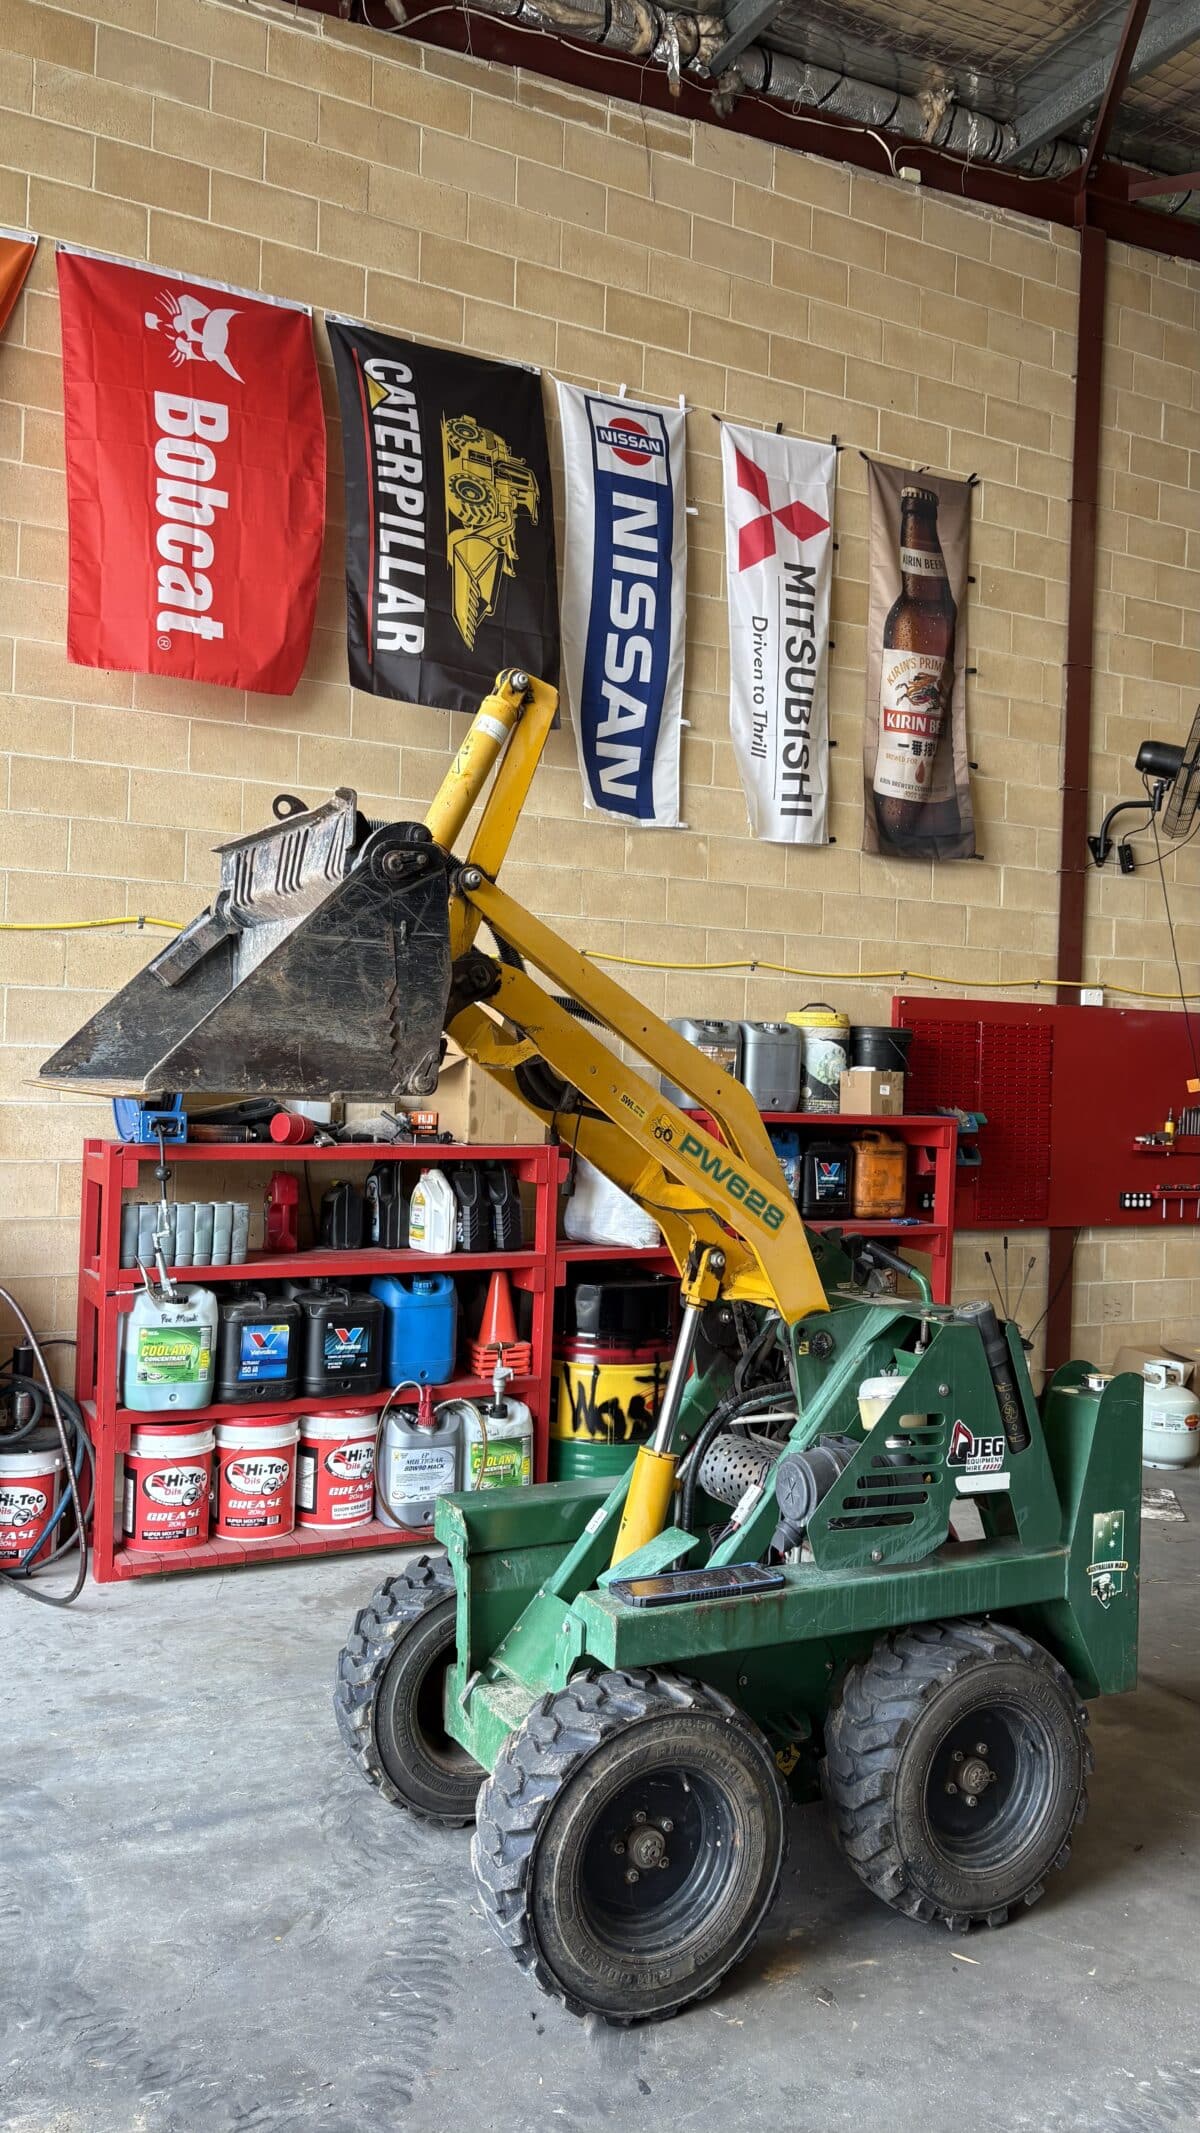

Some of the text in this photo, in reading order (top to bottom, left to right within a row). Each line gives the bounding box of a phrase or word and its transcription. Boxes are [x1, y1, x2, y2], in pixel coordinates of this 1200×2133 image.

[598, 429, 662, 454] NISSAN
[363, 358, 425, 654] CATERPILLAR
[154, 390, 229, 640] Bobcat
[902, 554, 922, 568] KIRIN
[596, 491, 658, 800] NISSAN
[887, 657, 917, 686] KIRIN'S
[751, 616, 768, 759] Driven to Thrill
[780, 562, 817, 816] MITSUBISHI
[886, 712, 927, 732] KIRIN
[677, 1132, 785, 1231] PW628
[141, 1344, 194, 1357] COOLANT
[348, 1447, 374, 1461] Hi-Te
[967, 1437, 1003, 1458] JEG
[345, 1461, 360, 1470] Oils
[473, 1453, 517, 1469] COLANT
[967, 1456, 1003, 1465] EQUIPMENT
[246, 1463, 288, 1476] Hi-Tec
[167, 1472, 207, 1487] Hi-Tec
[243, 1477, 261, 1485] Oils
[164, 1487, 182, 1496] Oils
[228, 1497, 283, 1509] GREASE
[147, 1507, 201, 1521] GREASE
[1088, 1563, 1114, 1573] AUSTRALIAN
